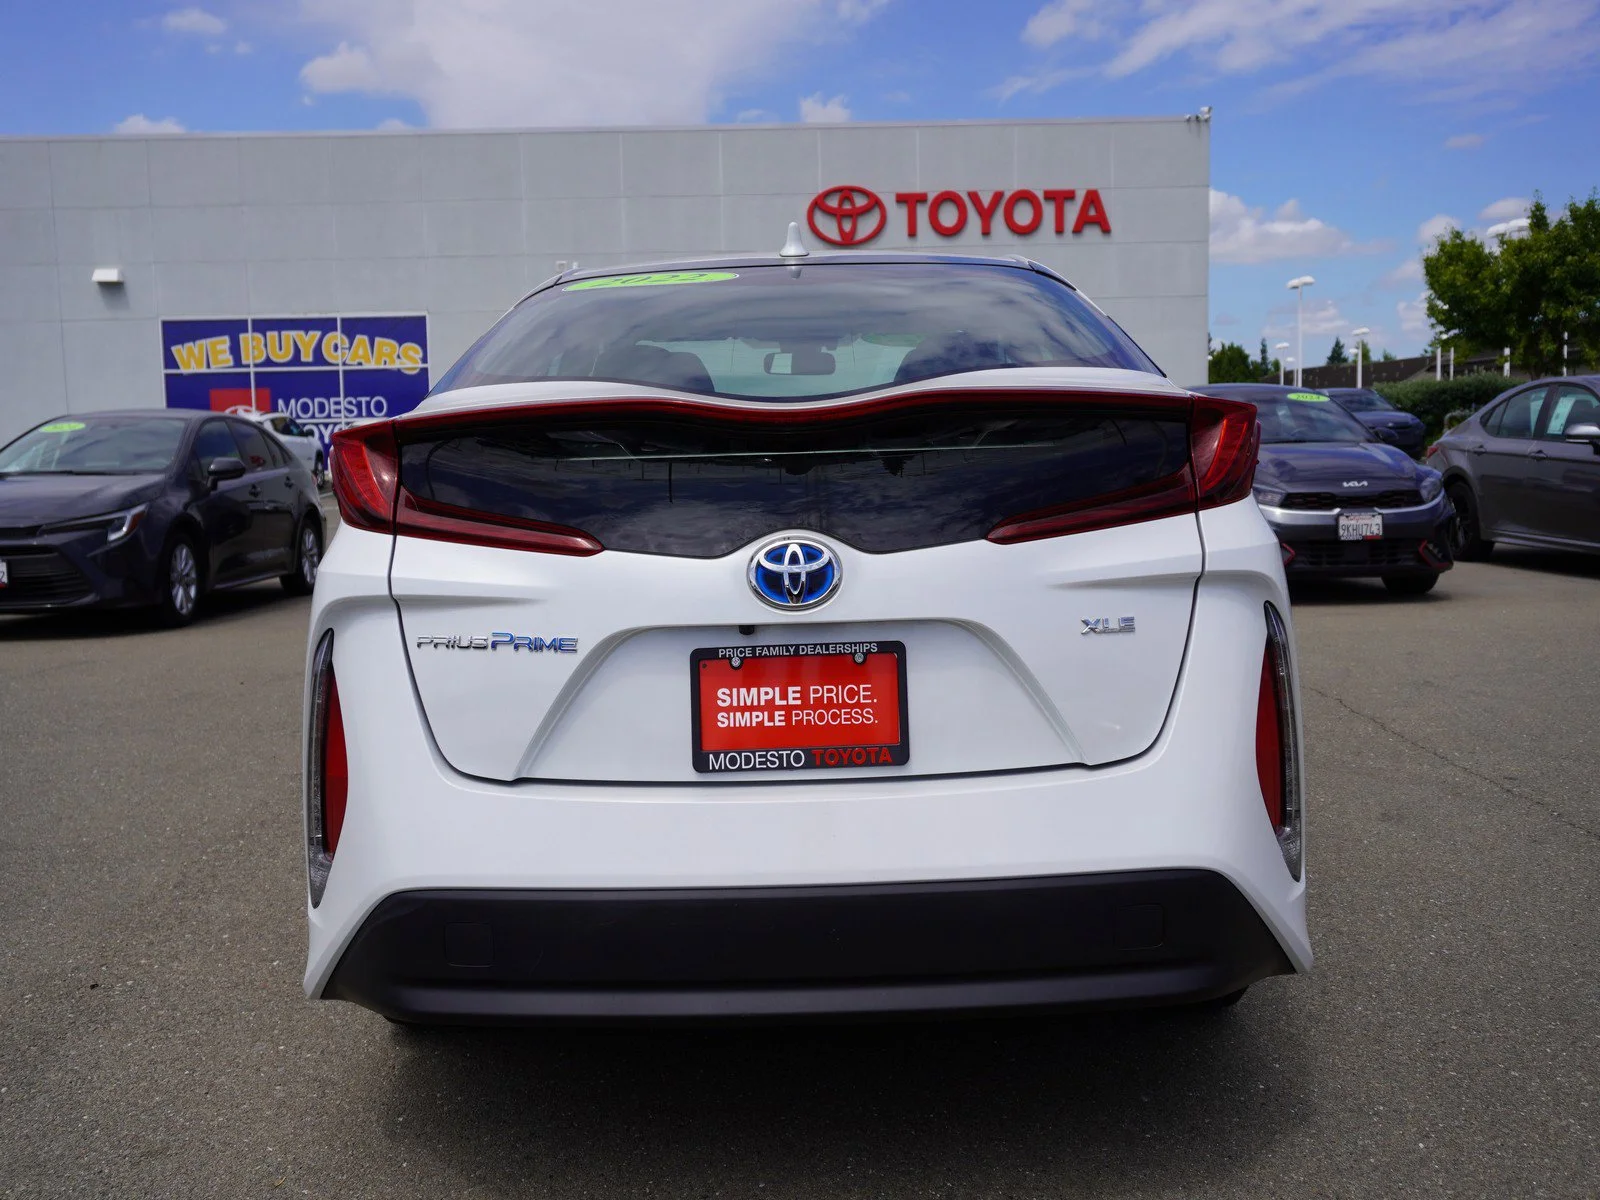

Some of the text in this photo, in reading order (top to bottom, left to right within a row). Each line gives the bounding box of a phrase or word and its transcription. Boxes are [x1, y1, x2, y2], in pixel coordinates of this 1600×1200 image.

[896, 189, 1111, 237] TOYOTA
[171, 330, 423, 375] WE BUY CARS
[277, 396, 387, 419] MODESTO
[1341, 523, 1380, 536] 9KHU743
[1080, 616, 1136, 635] XLE
[416, 632, 578, 653] PRIUS PRIME
[718, 643, 878, 658] PRICE FAMILY DEALERSHIPS
[716, 684, 878, 707] SIMPLE PRICE.
[716, 708, 879, 728] SIMPLE PROCESS.
[708, 747, 892, 771] MODESTO TOYOTA
